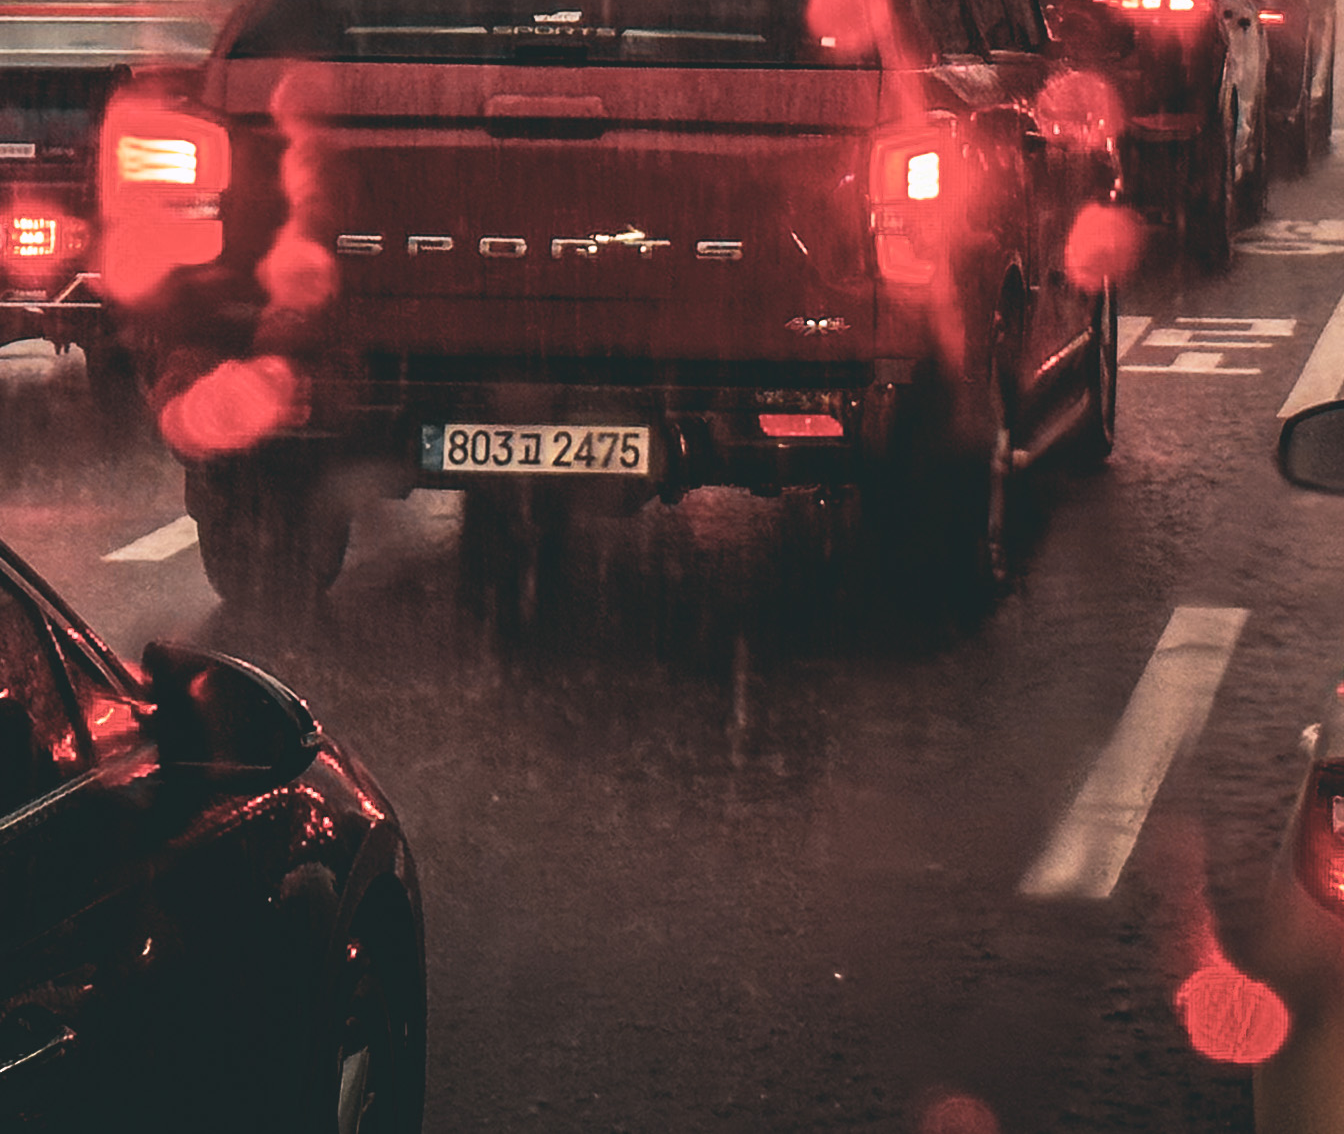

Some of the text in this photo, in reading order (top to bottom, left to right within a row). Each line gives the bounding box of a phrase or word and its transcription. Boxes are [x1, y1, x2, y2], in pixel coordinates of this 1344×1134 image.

[336, 230, 744, 261] SPORTS
[447, 429, 640, 468] 803고 2475
